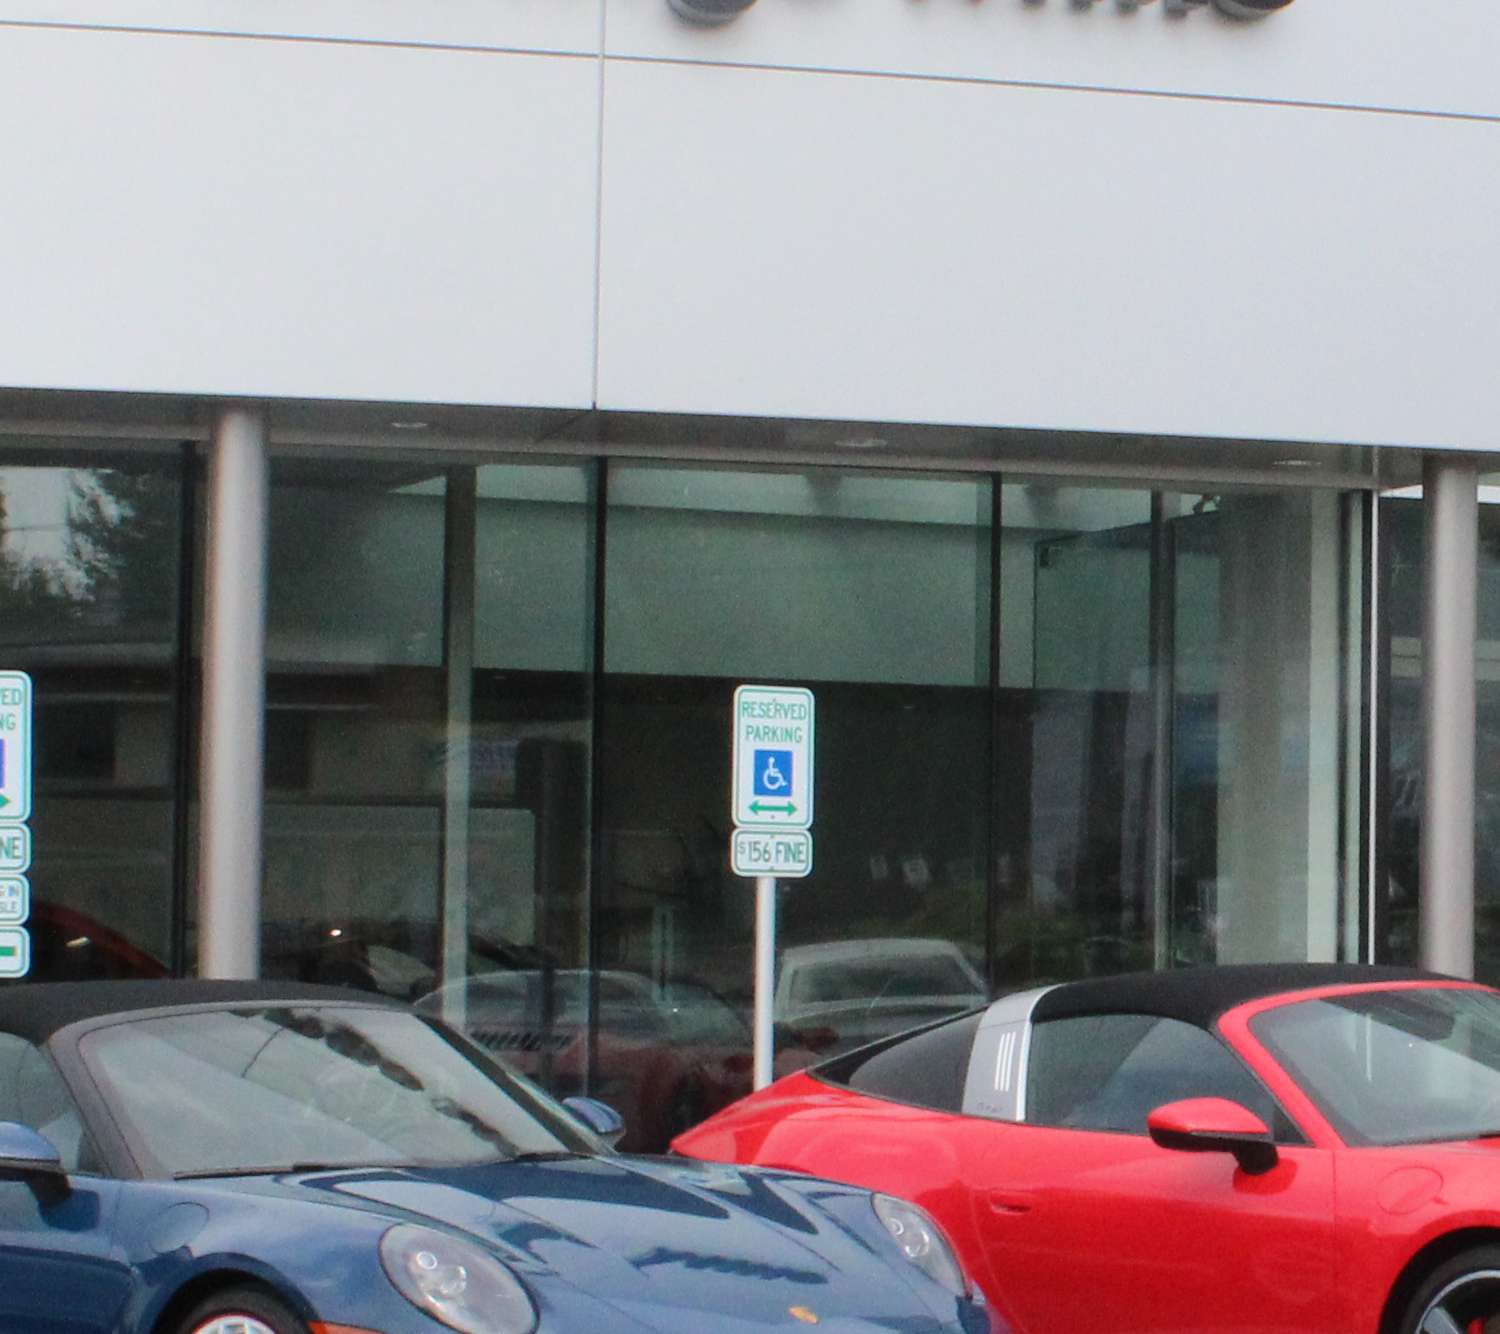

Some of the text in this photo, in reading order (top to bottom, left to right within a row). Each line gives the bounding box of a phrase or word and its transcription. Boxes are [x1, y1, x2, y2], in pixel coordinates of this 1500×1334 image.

[741, 701, 808, 720] RESERVED
[745, 725, 803, 743] PARKING
[775, 841, 806, 863] FINE
[7, 885, 20, 897] IN
